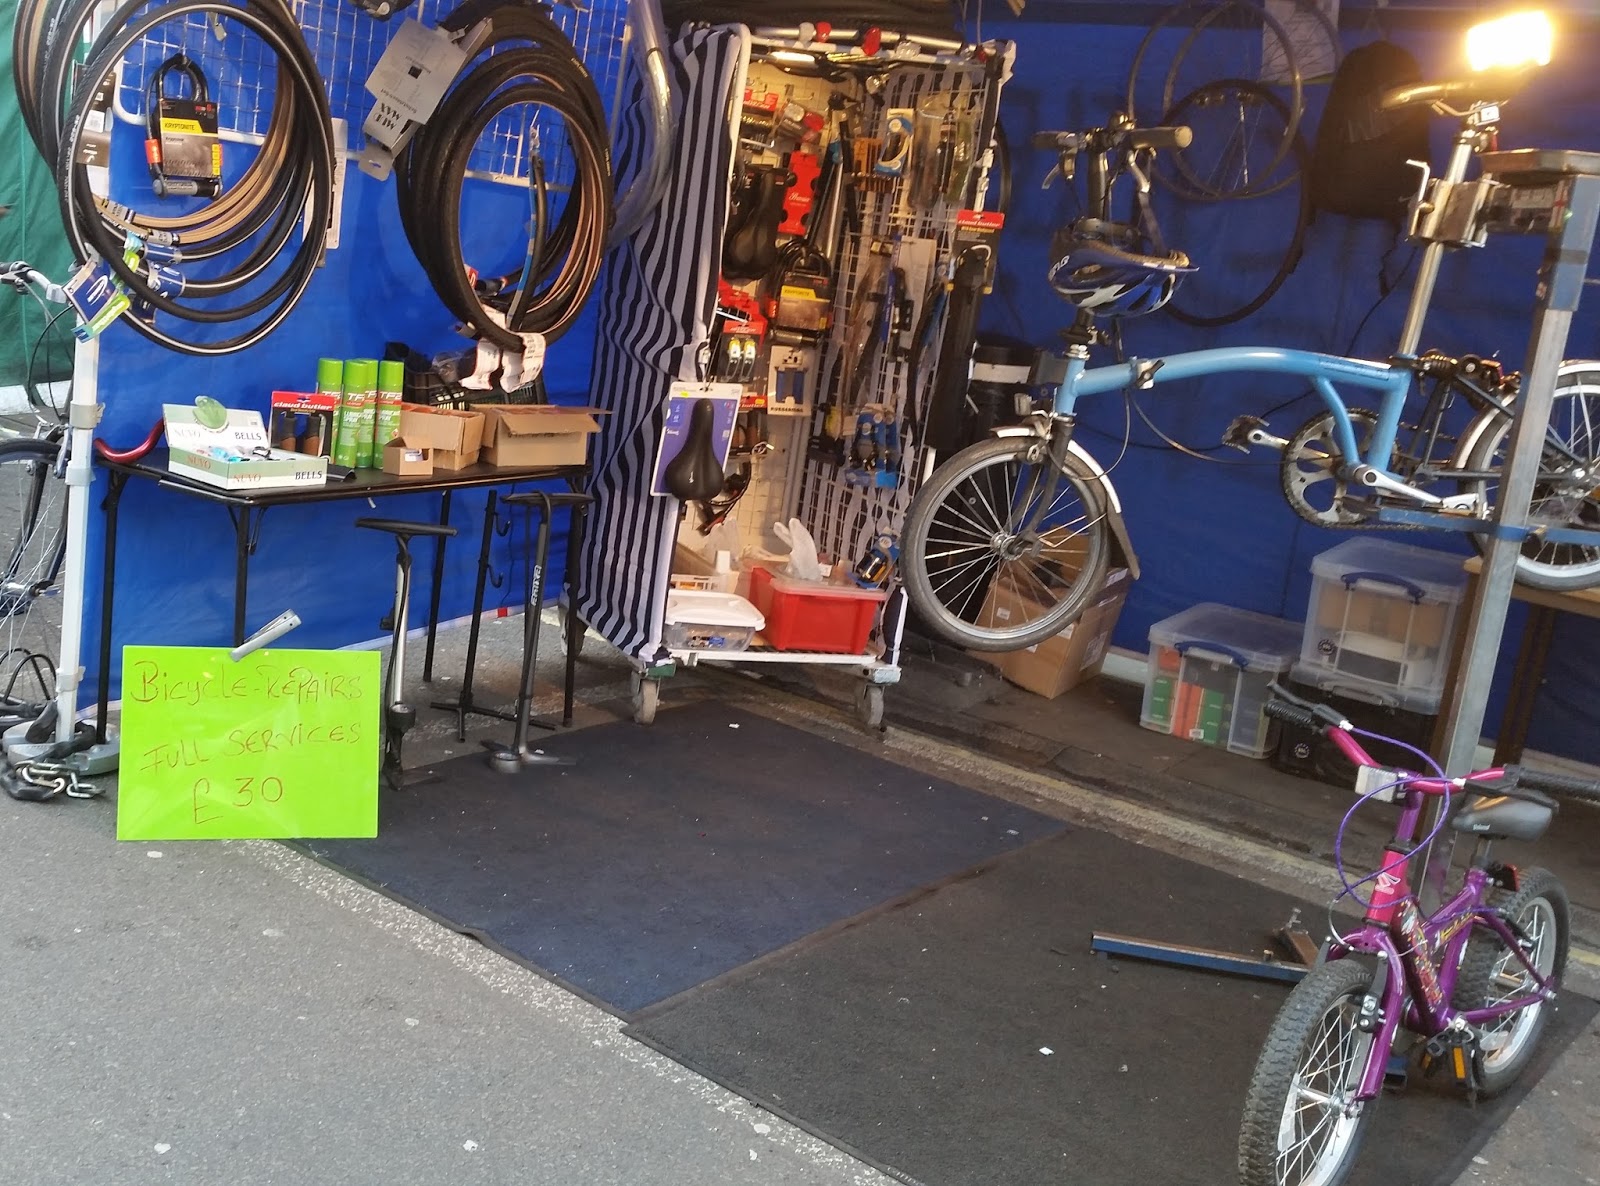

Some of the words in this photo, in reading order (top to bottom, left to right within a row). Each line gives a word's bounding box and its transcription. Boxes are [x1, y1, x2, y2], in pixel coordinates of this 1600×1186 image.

[164, 122, 196, 131] KRYPTONITE
[273, 401, 301, 409] claud
[302, 401, 333, 410] butler
[234, 432, 262, 441] BELLS
[187, 455, 212, 469] NUVO
[232, 473, 262, 483] NUVO
[295, 470, 323, 481] BELLS
[140, 738, 209, 774] FULL
[222, 723, 361, 757] SERVICES
[232, 776, 283, 807] 30
